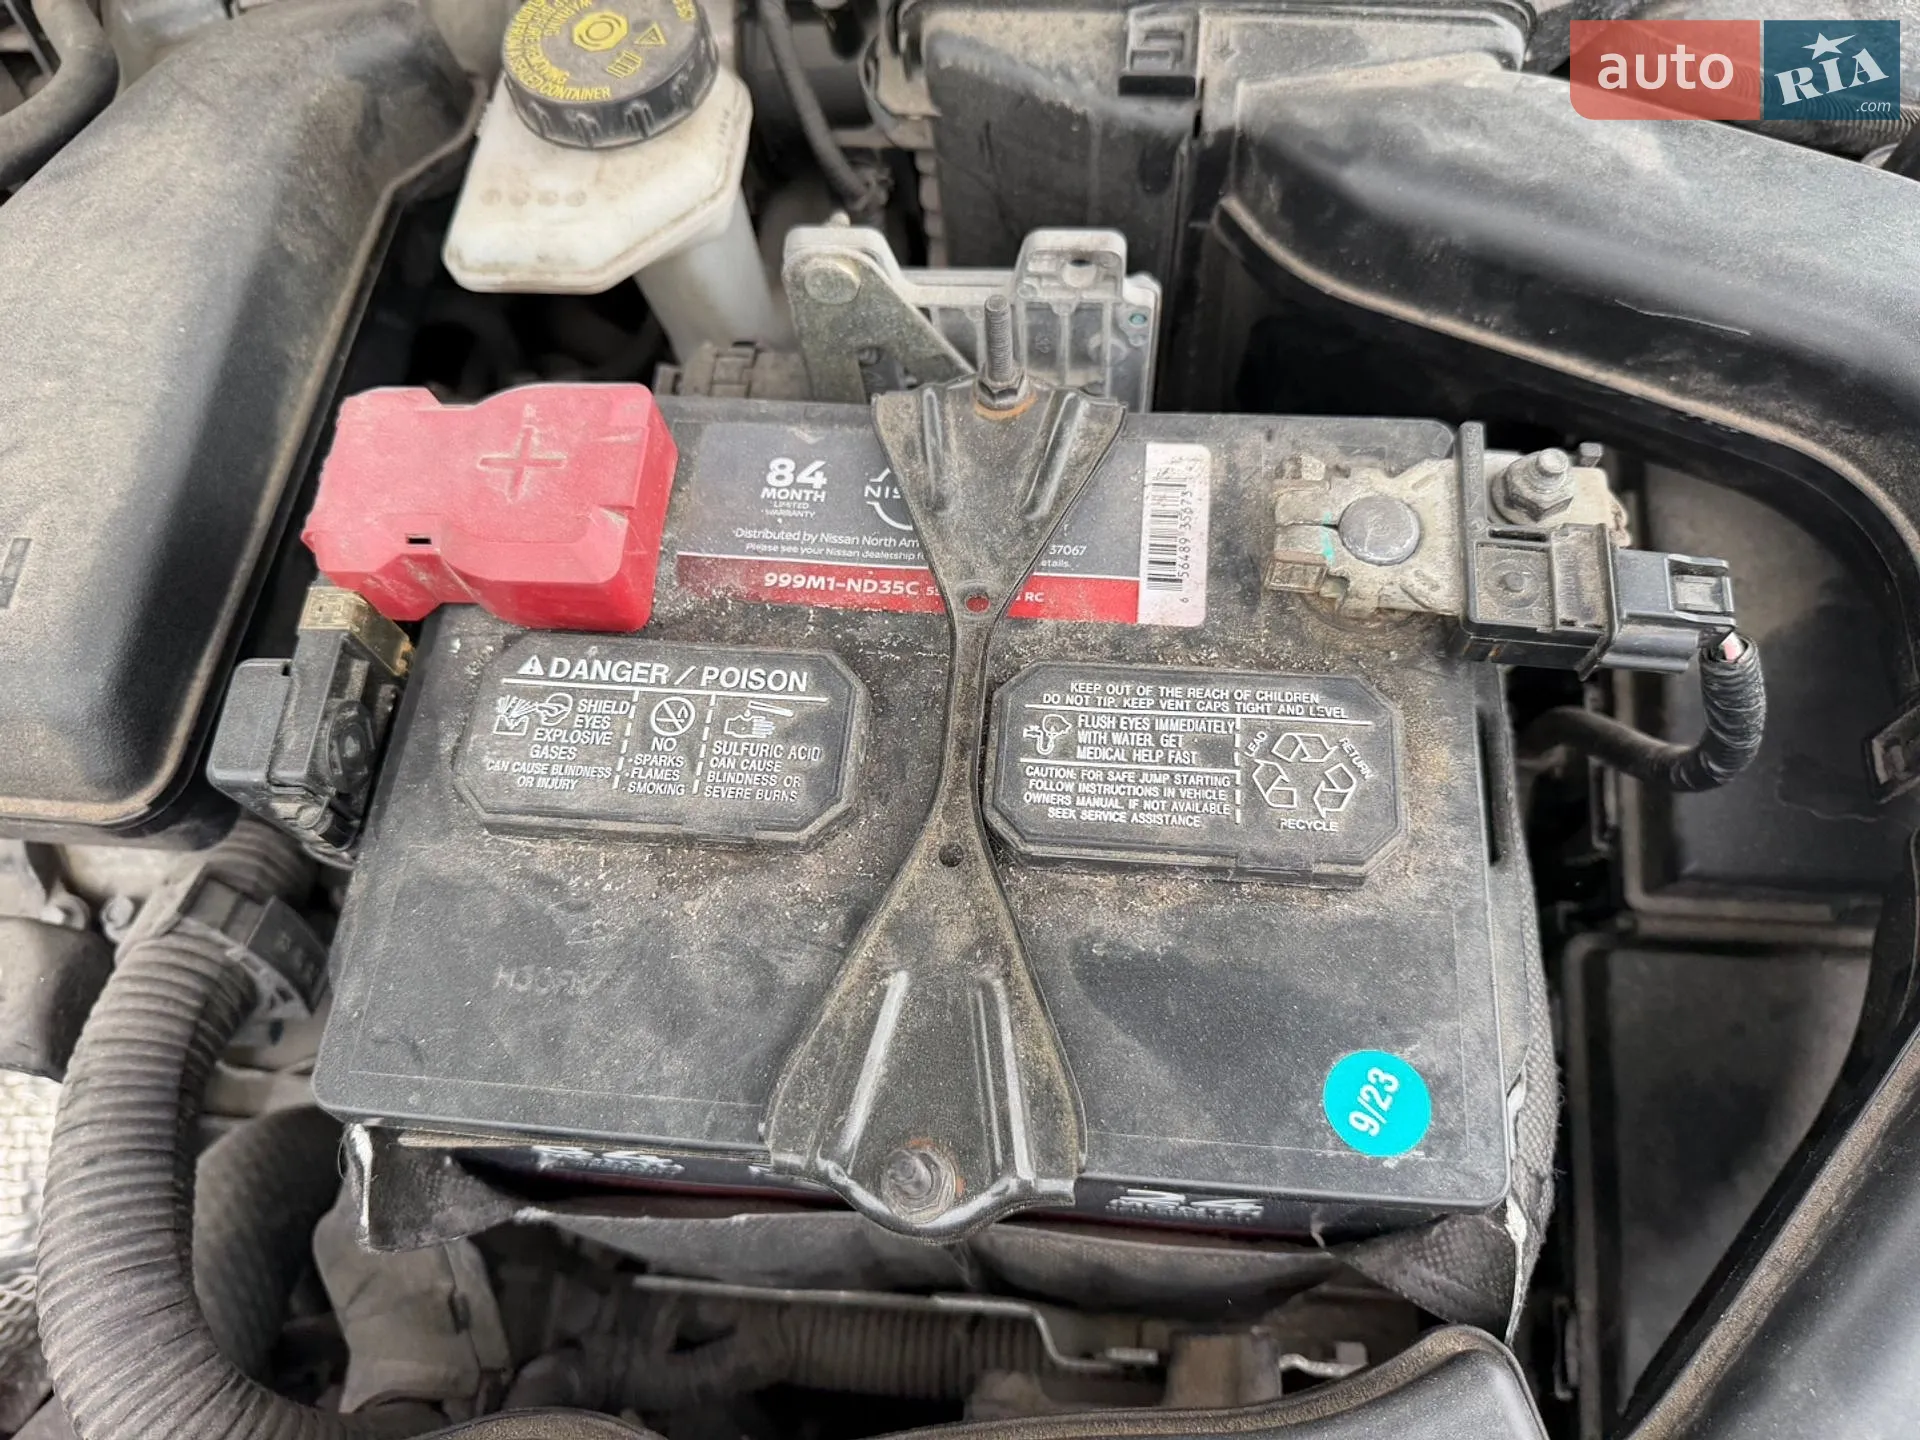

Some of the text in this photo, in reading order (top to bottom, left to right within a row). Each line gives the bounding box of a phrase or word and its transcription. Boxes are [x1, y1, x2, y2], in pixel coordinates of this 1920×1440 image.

[539, 81, 611, 100] CONTAINER
[765, 457, 828, 489] 84
[760, 487, 827, 503] MONTH
[764, 508, 816, 519] WARRANTY
[773, 500, 810, 510] LIMITED
[734, 527, 801, 541] Distributed
[802, 530, 818, 545] by
[819, 532, 860, 546] Nissan
[861, 535, 897, 548] North
[1048, 544, 1088, 556] 37067
[1177, 489, 1193, 604] 6 56489 35673
[744, 542, 779, 553] Please
[780, 544, 799, 554] see
[800, 545, 825, 556] your
[825, 547, 860, 558] Nissan
[861, 549, 915, 561] dealership
[763, 572, 920, 598] 999M1-ND35C
[549, 656, 670, 685] DANGER
[699, 665, 808, 692] POISON
[1070, 682, 1320, 704] KEEP OUT OF THE REACH OF CHILDREN
[577, 698, 631, 715] SHIELD
[1042, 693, 1349, 719] DO NOT TIP. KEEP VENT CAPS TIGHT AND LEVEL
[573, 715, 612, 730] EYES
[1077, 714, 1235, 734] FLUSH EYES IMMEDIATELY
[532, 727, 614, 746] EXPLOSIVE
[650, 737, 677, 752] NO
[1077, 729, 1107, 745] WITH
[1160, 733, 1184, 748] GET
[1243, 730, 1269, 759] LEAD
[529, 743, 578, 761] GASES
[633, 753, 685, 768] SPARKS
[712, 740, 822, 762] SULFURIC ACID
[1076, 745, 1198, 764] MEDICAL HELP FAST
[1338, 736, 1376, 781] RETURN
[485, 759, 613, 779] CAN CAUSE BLINDNESS
[629, 768, 681, 782] FLAMES
[709, 758, 783, 773] CAN CAUSE
[516, 775, 579, 790] OR INJURY
[706, 771, 802, 788] BLINDNESS OR
[1081, 769, 1104, 782] FOR
[1106, 770, 1136, 783] SAFE
[1139, 772, 1170, 784] JUMP
[1173, 773, 1231, 787] STARTING
[627, 781, 686, 797] SMOKING
[703, 785, 798, 802] SEVERE BURNS
[1028, 778, 1227, 801] FOLLOW INSTRUCTIONS IN VEHICLE
[1023, 791, 1072, 806] OWNERS
[1128, 798, 1140, 810] IF
[1142, 799, 1168, 812] NOT
[1170, 801, 1231, 815] AVAILABLE
[1047, 806, 1202, 828] SEEK SERVICE ASSISTANCE
[1279, 817, 1340, 833] RECYCLE
[1347, 1066, 1400, 1137] 9/23
